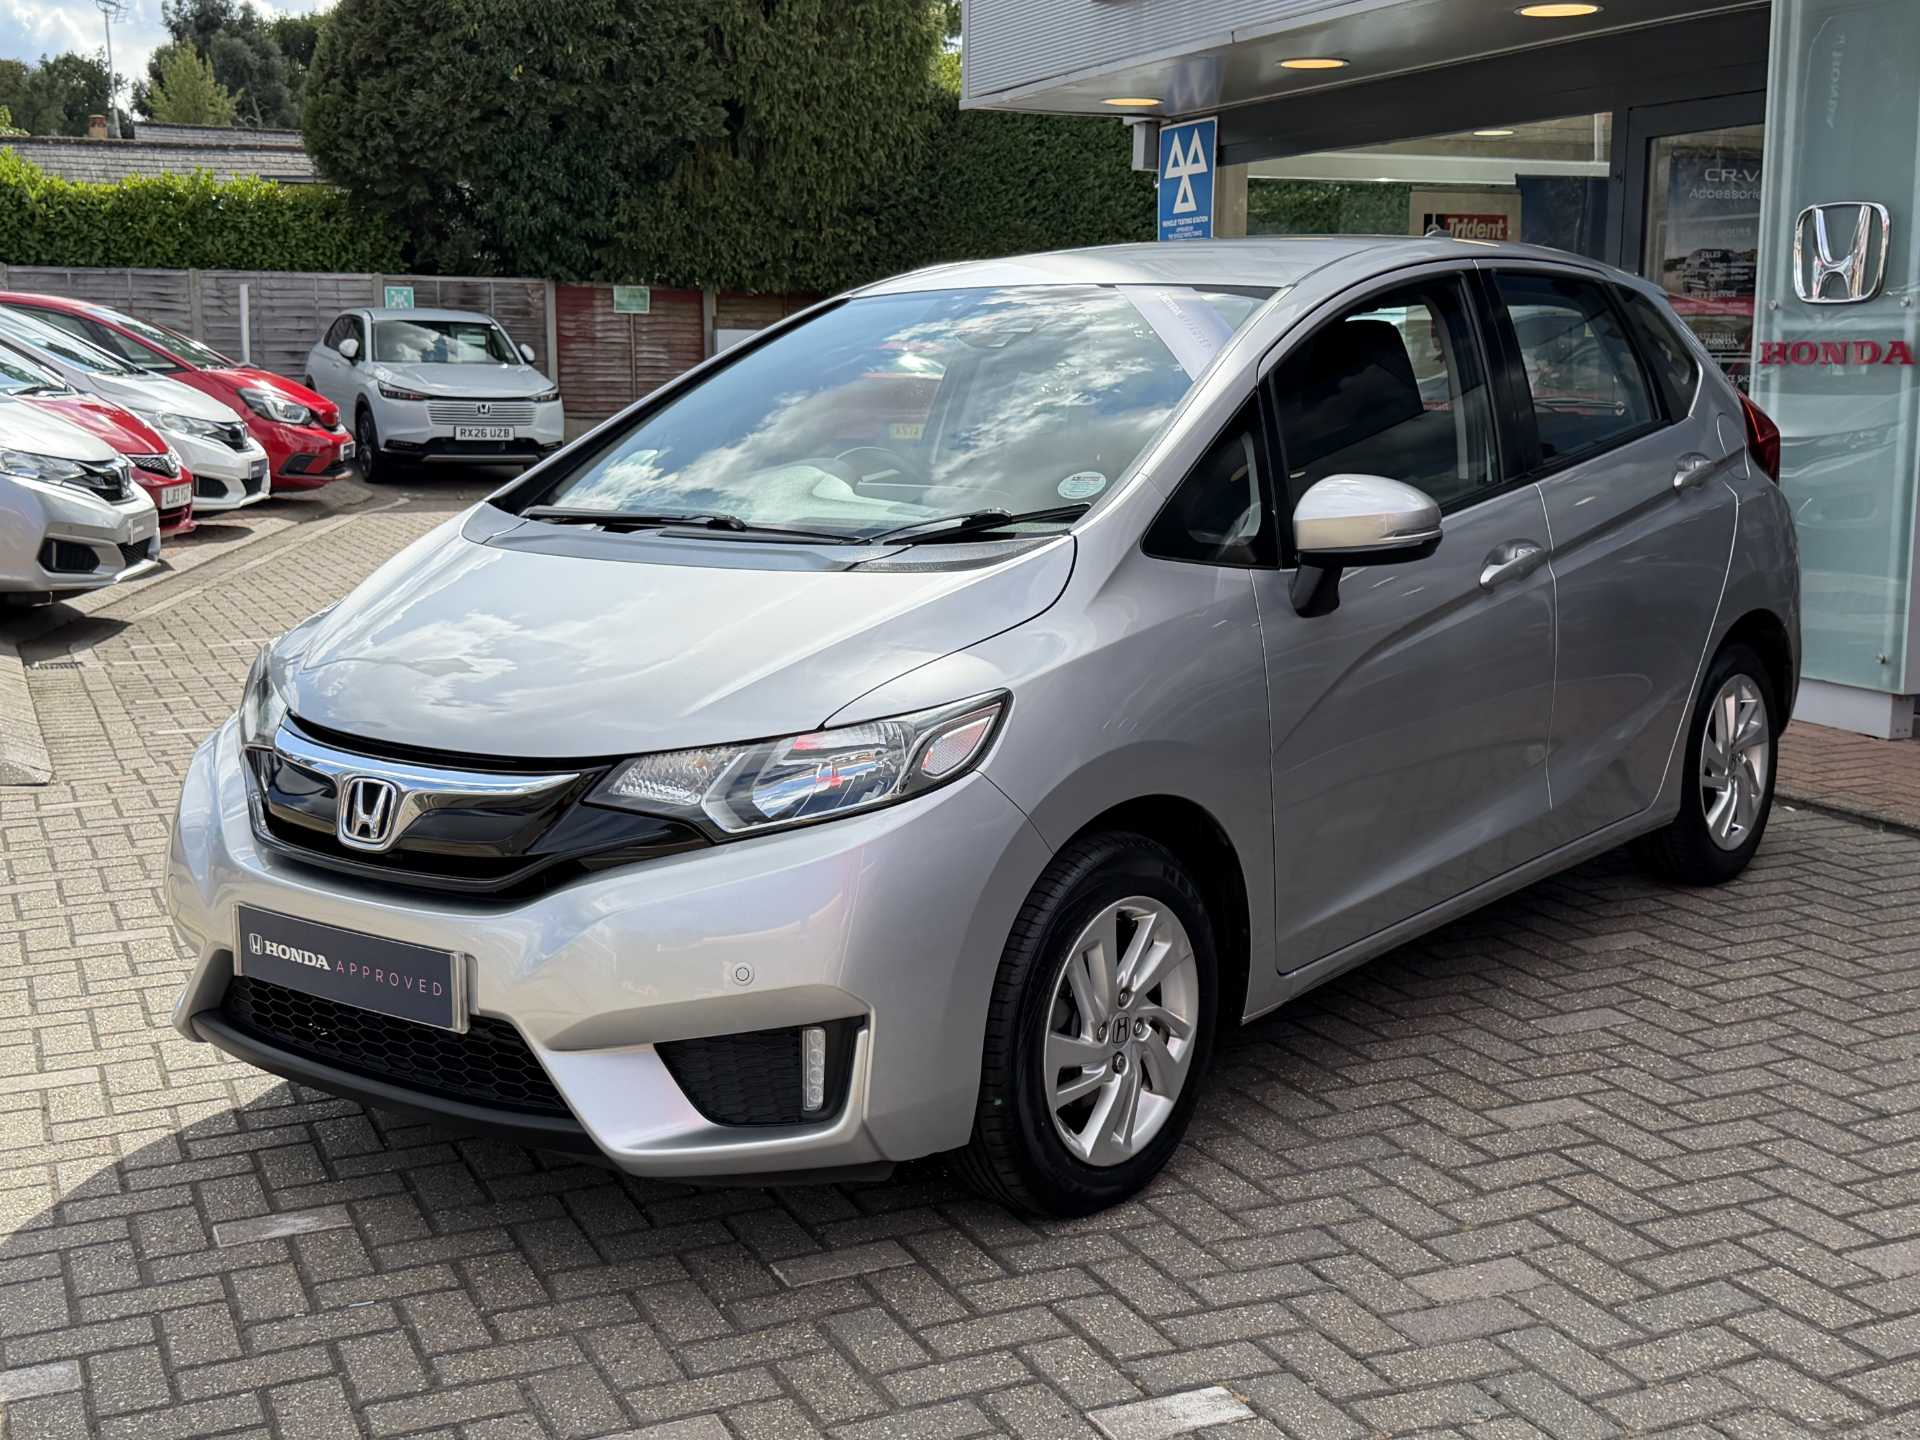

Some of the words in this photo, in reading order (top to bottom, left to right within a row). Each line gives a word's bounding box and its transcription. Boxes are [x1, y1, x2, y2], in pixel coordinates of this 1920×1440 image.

[1447, 218, 1505, 239] Trident
[1759, 341, 1915, 366] HONDA
[460, 428, 487, 438] RX26
[264, 940, 331, 971] HONDA
[336, 960, 443, 997] APPROVED
